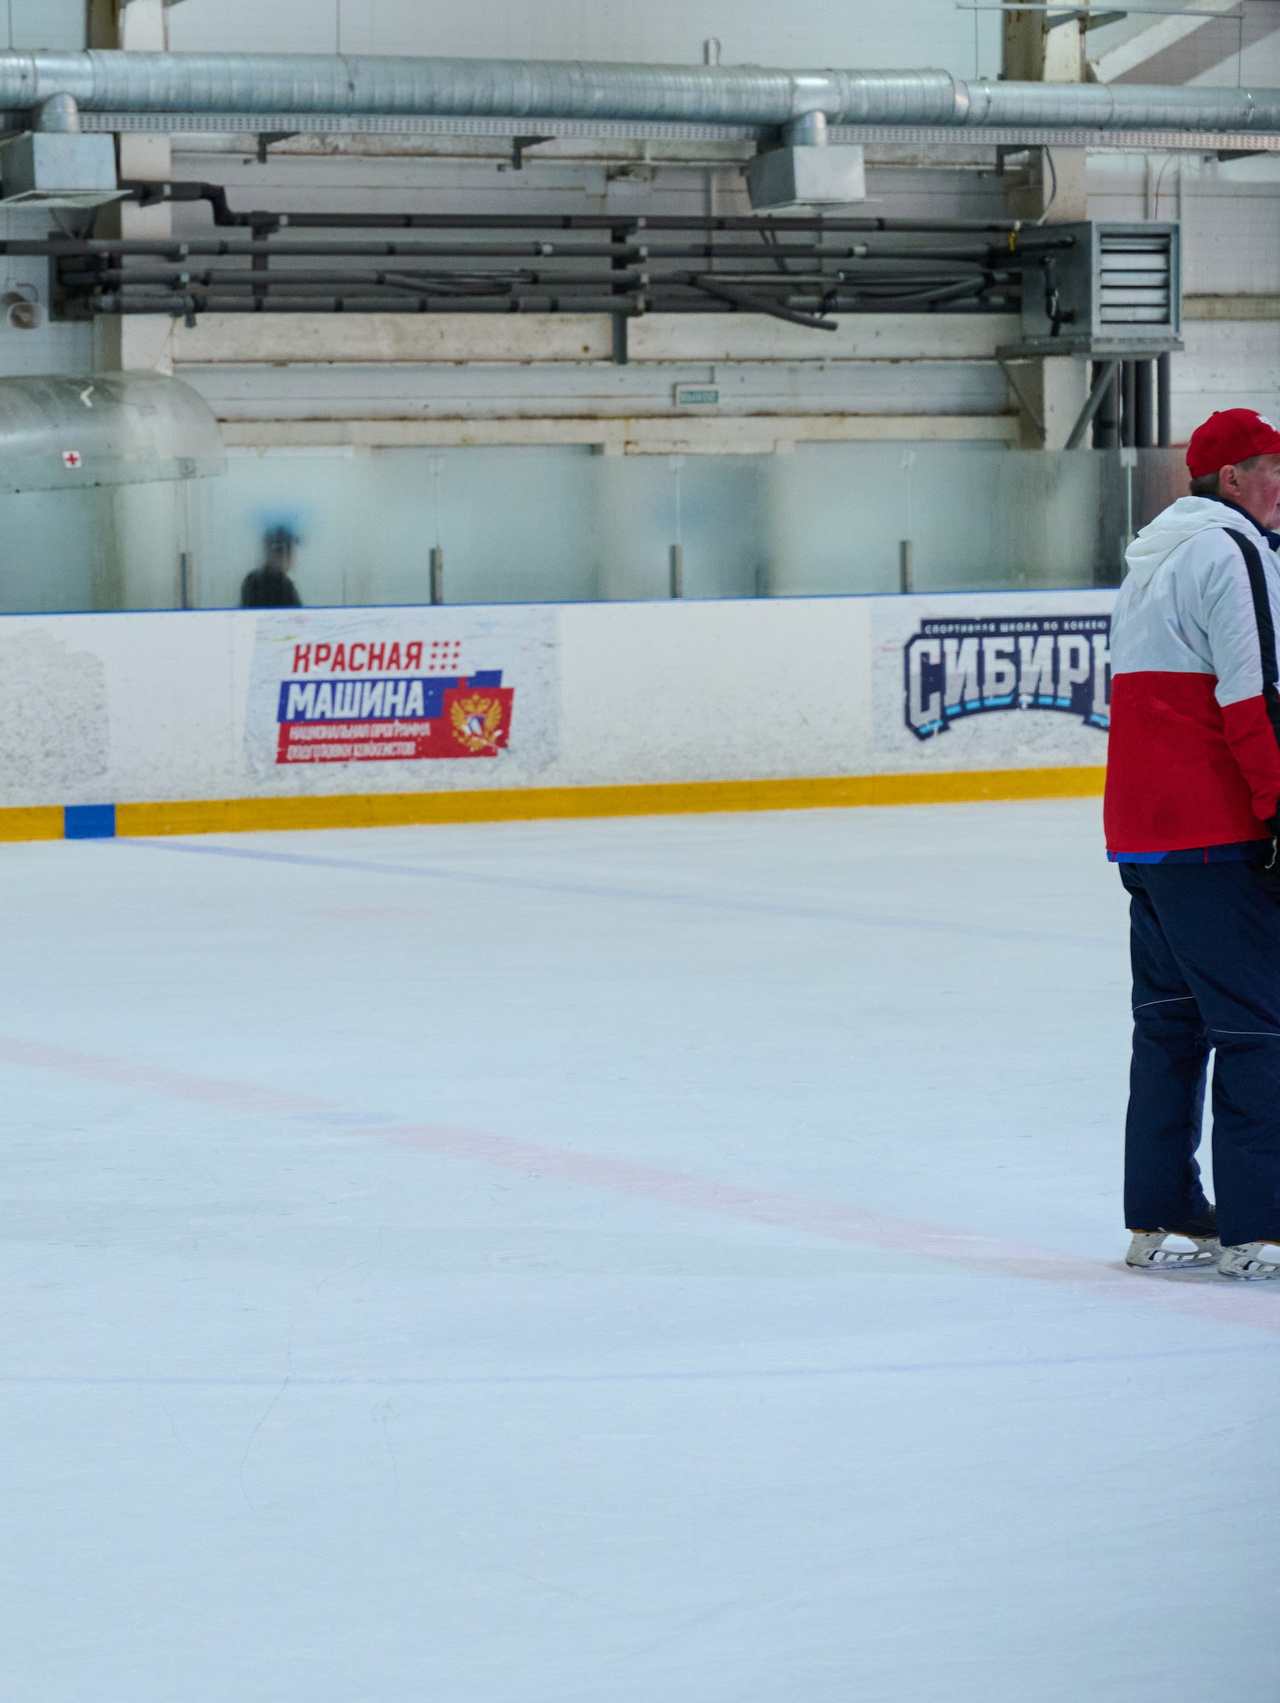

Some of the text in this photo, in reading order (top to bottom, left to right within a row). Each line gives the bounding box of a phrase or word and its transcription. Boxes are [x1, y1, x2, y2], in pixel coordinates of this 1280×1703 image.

[1000, 621, 1039, 633] ШКОЛА
[1043, 621, 1059, 631] ПО
[1063, 619, 1107, 631] ХОККЕЮ
[292, 640, 423, 673] КРАСНАЯ
[286, 680, 426, 721] МАШИНА
